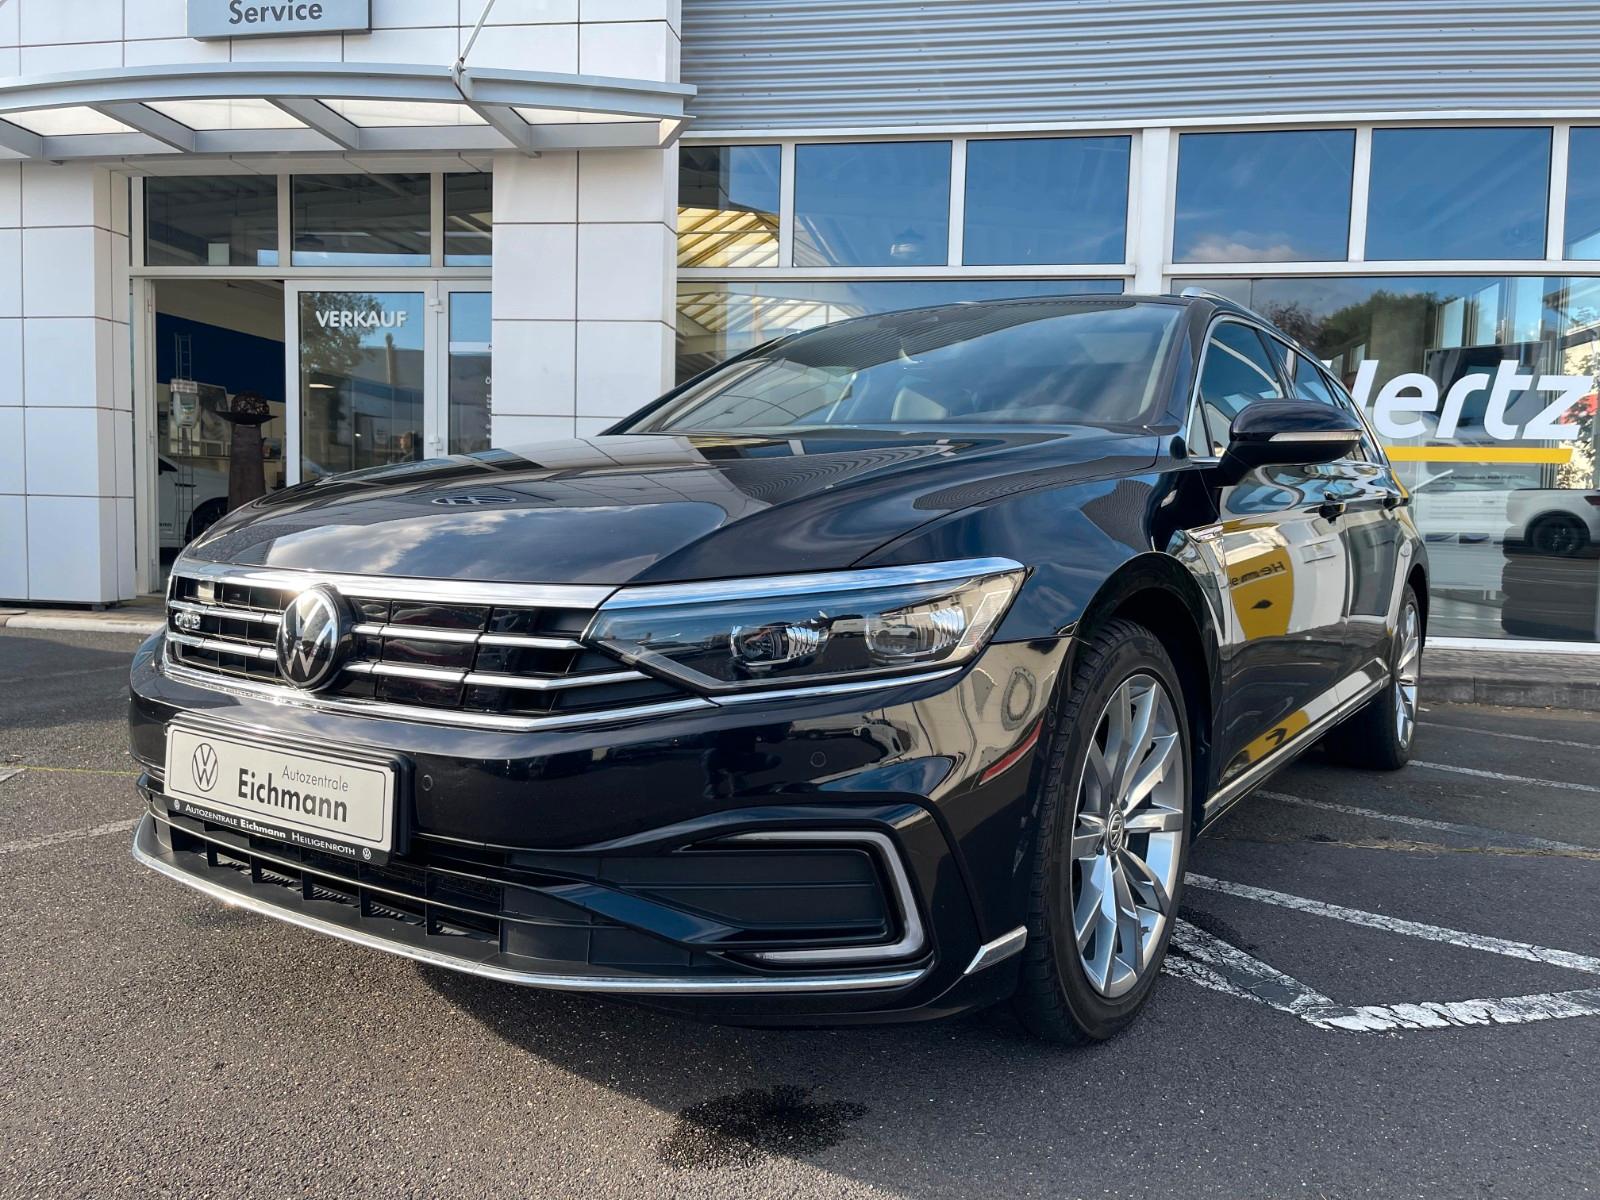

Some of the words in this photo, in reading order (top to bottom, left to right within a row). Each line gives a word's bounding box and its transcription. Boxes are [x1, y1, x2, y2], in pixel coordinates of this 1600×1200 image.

[228, 0, 323, 24] Service
[315, 310, 407, 328] VERKAUF
[282, 765, 349, 792] Autozentrale
[238, 767, 348, 823] Eichmann
[185, 804, 238, 826] AUTOZENTRALE
[240, 819, 287, 839] Eichmann
